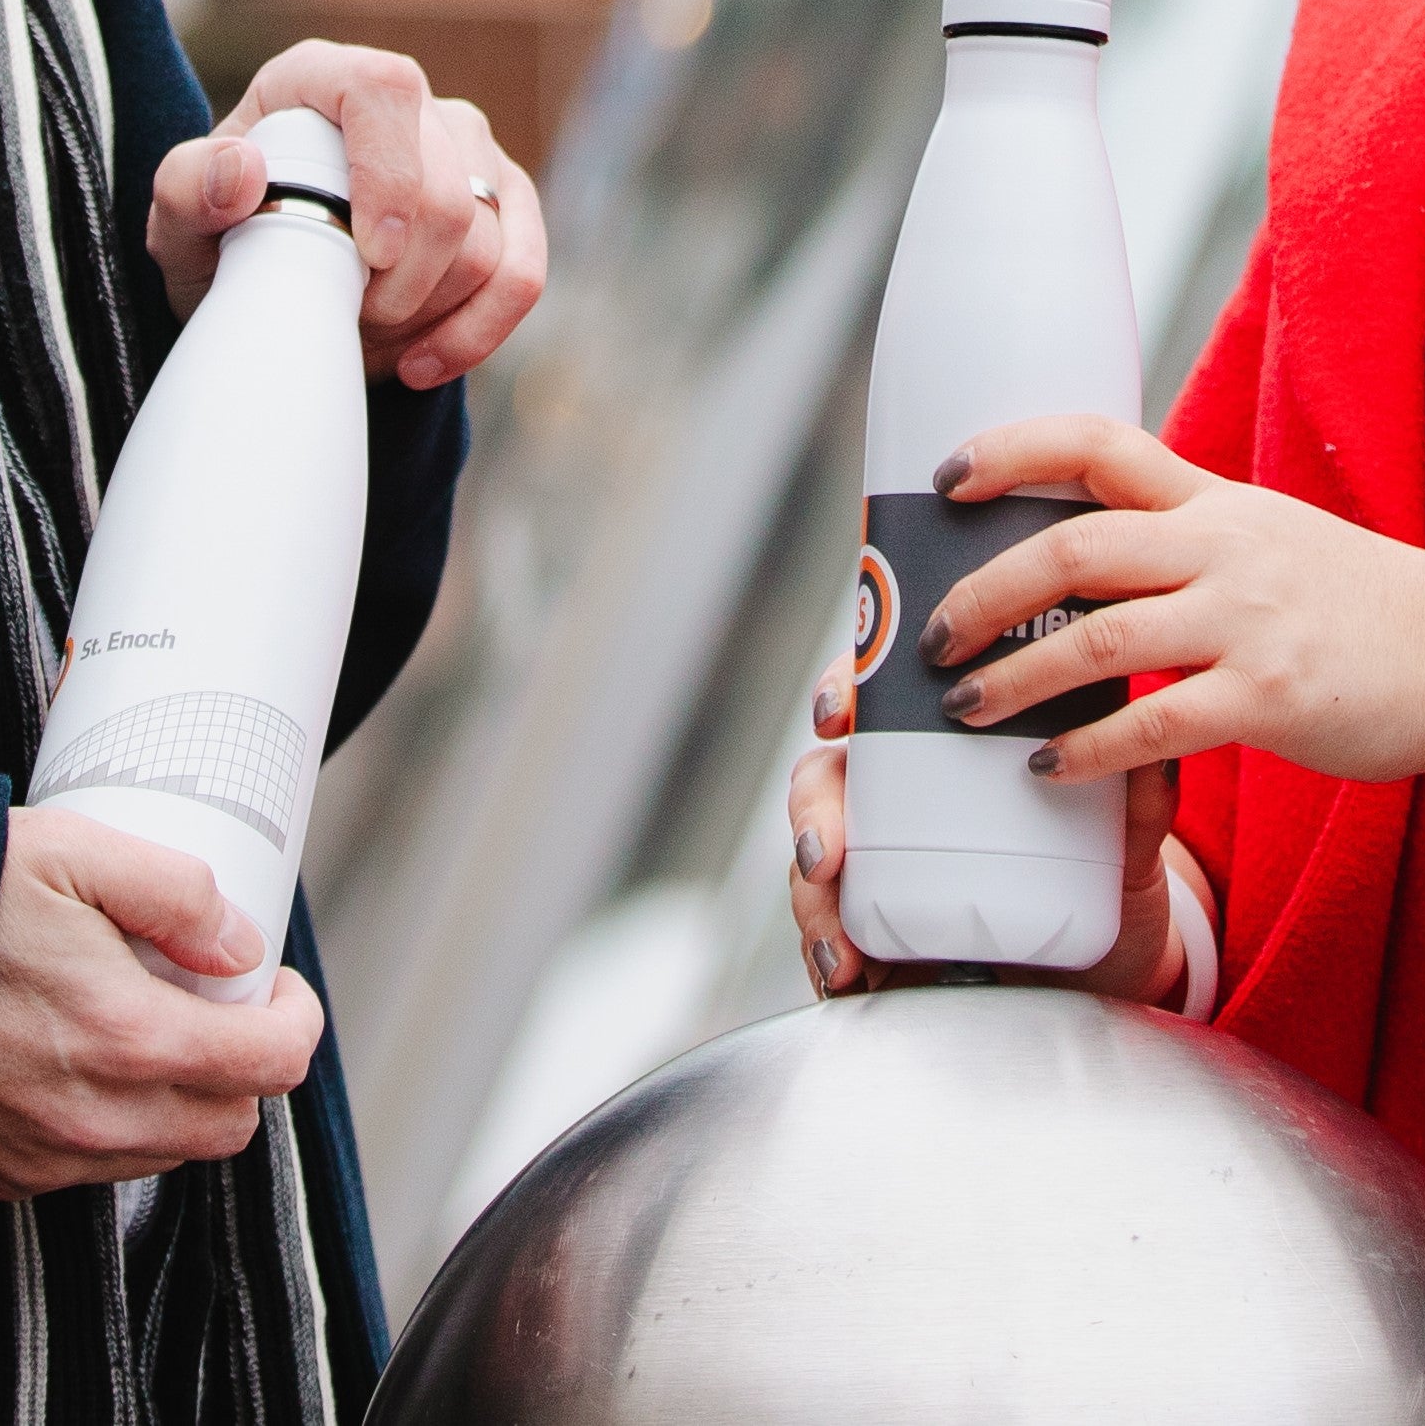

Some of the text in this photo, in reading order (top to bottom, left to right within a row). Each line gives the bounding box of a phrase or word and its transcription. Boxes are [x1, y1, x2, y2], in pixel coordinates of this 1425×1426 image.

[858, 596, 867, 633] S
[79, 628, 176, 661] St. Enoch
